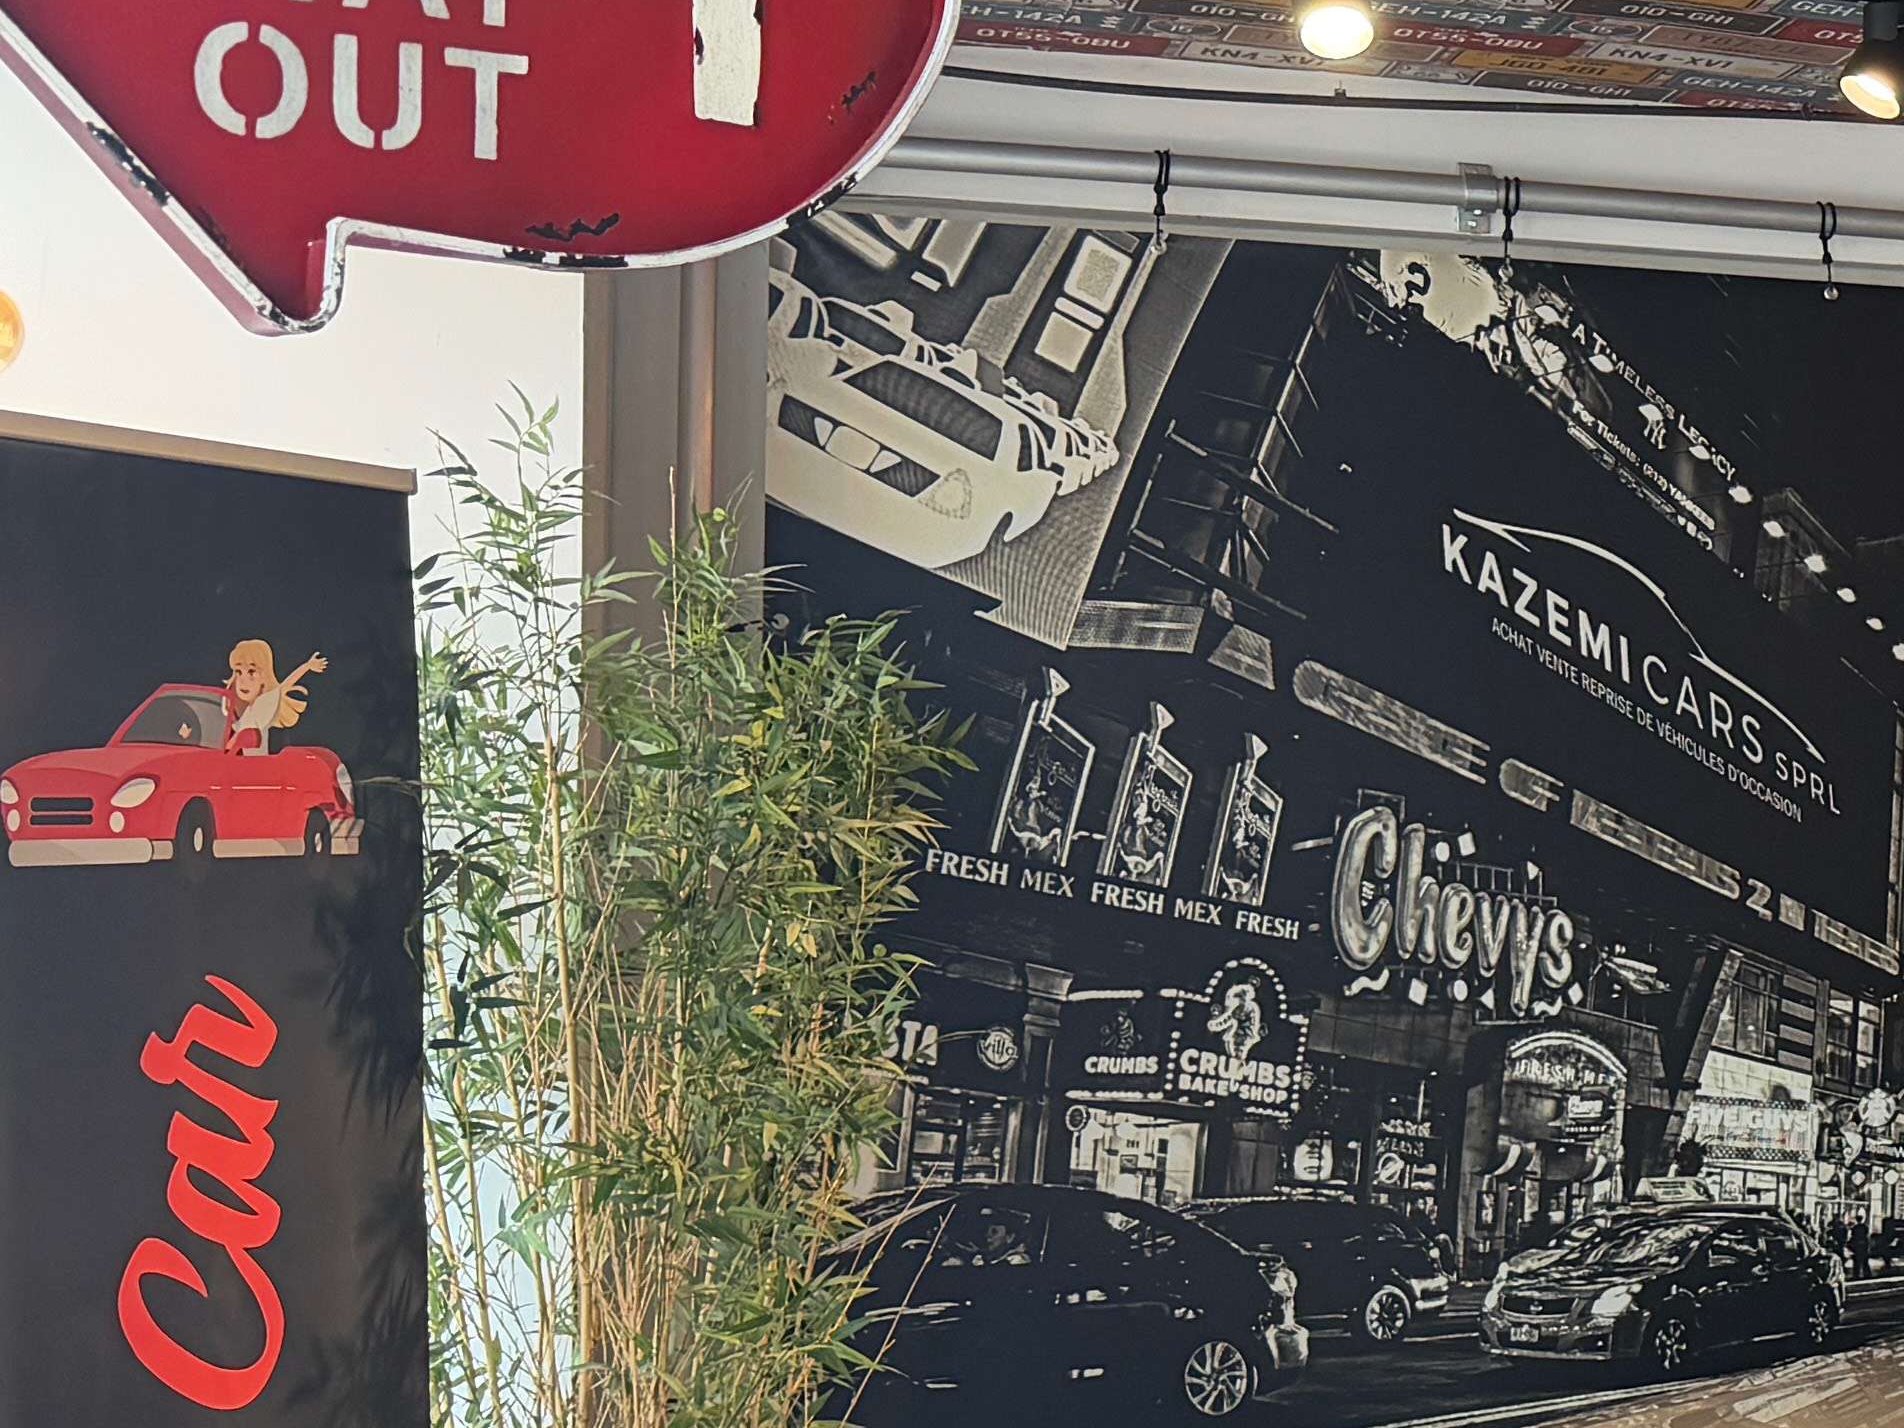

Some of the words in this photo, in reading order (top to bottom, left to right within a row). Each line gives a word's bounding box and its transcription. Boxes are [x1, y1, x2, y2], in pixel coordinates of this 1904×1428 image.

[192, 21, 530, 161] OUT
[1492, 617, 1533, 656] ACHAT
[1537, 645, 1579, 685] VENTE
[1581, 672, 1634, 720] REPRISE
[1636, 706, 1655, 733] DE
[1655, 719, 1725, 777] VÉHICULES
[1727, 762, 1803, 823] D'OCCASION
[1775, 751, 1841, 815] SPRL
[925, 848, 1009, 887] FRESH
[1020, 869, 1075, 898] MEX
[1090, 881, 1165, 915] FRESH
[1174, 898, 1222, 926] MEX
[1236, 910, 1300, 941] FRESH
[1332, 806, 1573, 1016] Chevys
[1084, 1055, 1159, 1076] CRUMBS
[1180, 1048, 1291, 1089] CRUMBS
[1239, 1082, 1288, 1105] SHOP
[117, 974, 286, 1412] Car
